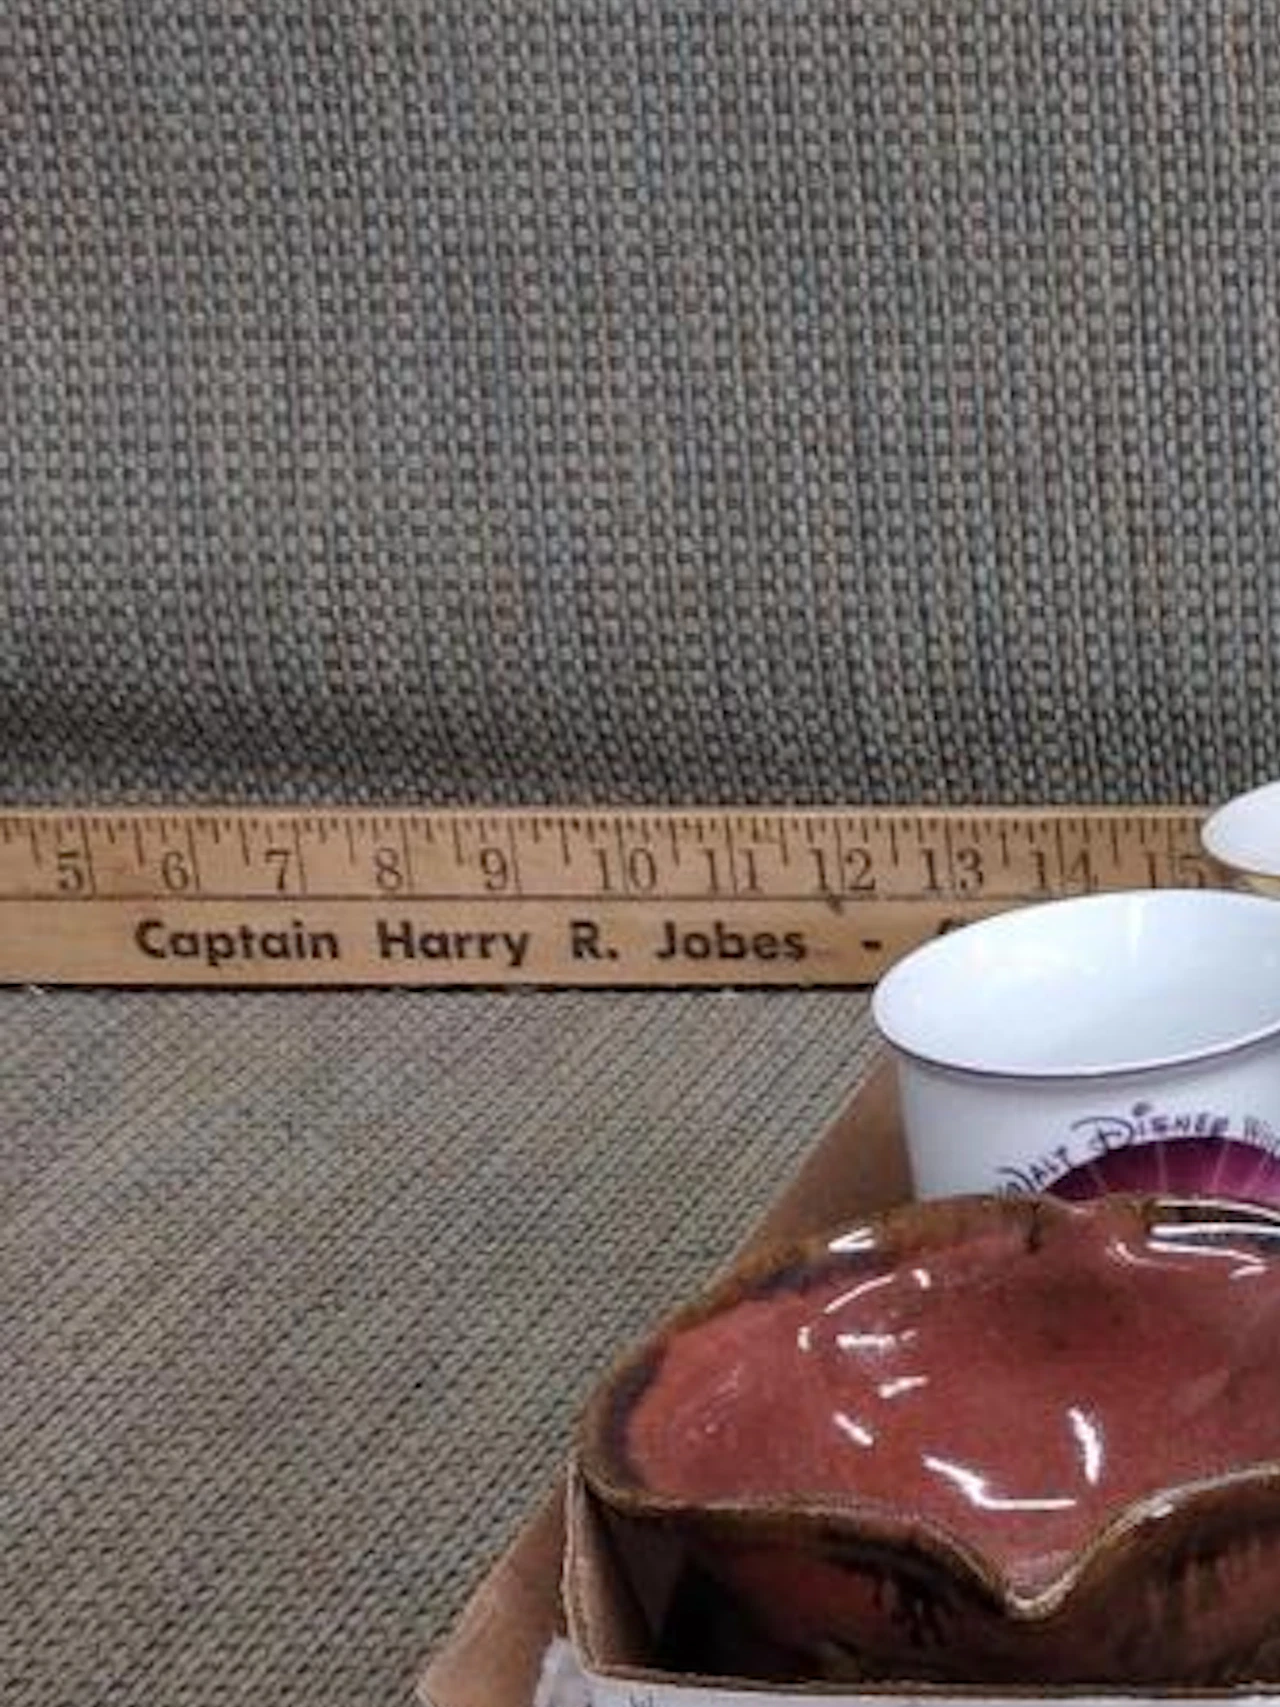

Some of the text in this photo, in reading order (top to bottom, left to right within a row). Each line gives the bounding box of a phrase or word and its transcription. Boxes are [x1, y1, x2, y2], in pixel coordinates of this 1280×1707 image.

[57, 850, 85, 892] 5
[161, 850, 190, 892] 6
[263, 849, 293, 892] 7
[373, 848, 404, 892] 8
[479, 847, 510, 892] 9
[596, 848, 657, 892] 10
[702, 848, 763, 892] 11
[811, 848, 876, 892] 12
[921, 848, 985, 892] 13
[1030, 849, 1099, 891] 14
[134, 919, 340, 969] Captain
[376, 920, 532, 968] Harry
[570, 921, 619, 961] R.
[654, 919, 809, 961] Jobes
